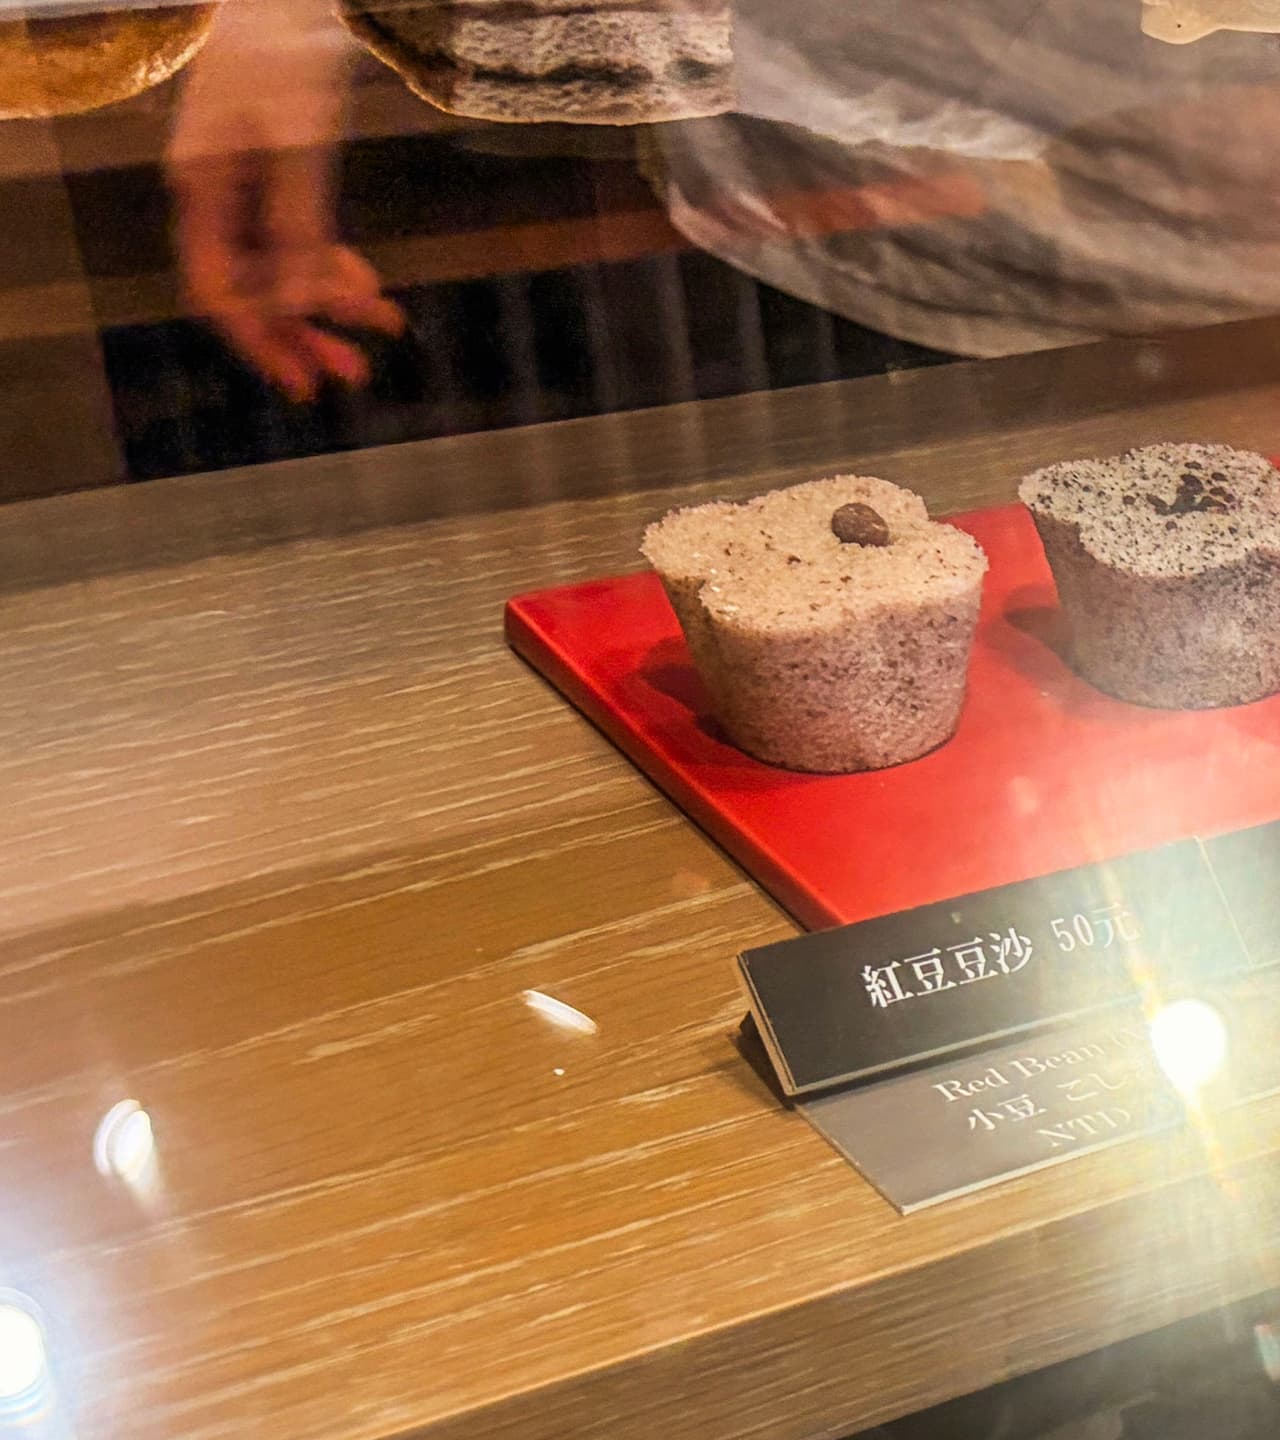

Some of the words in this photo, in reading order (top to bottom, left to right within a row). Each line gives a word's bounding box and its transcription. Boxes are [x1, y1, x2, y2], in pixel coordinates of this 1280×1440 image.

[860, 926, 1034, 1009] 紅豆豆沙
[1050, 905, 1141, 953] 50元
[932, 1067, 1010, 1103] Red
[1008, 1041, 1106, 1079] Bean
[967, 1093, 1049, 1131] 小豆
[1035, 1106, 1132, 1148] NTD
